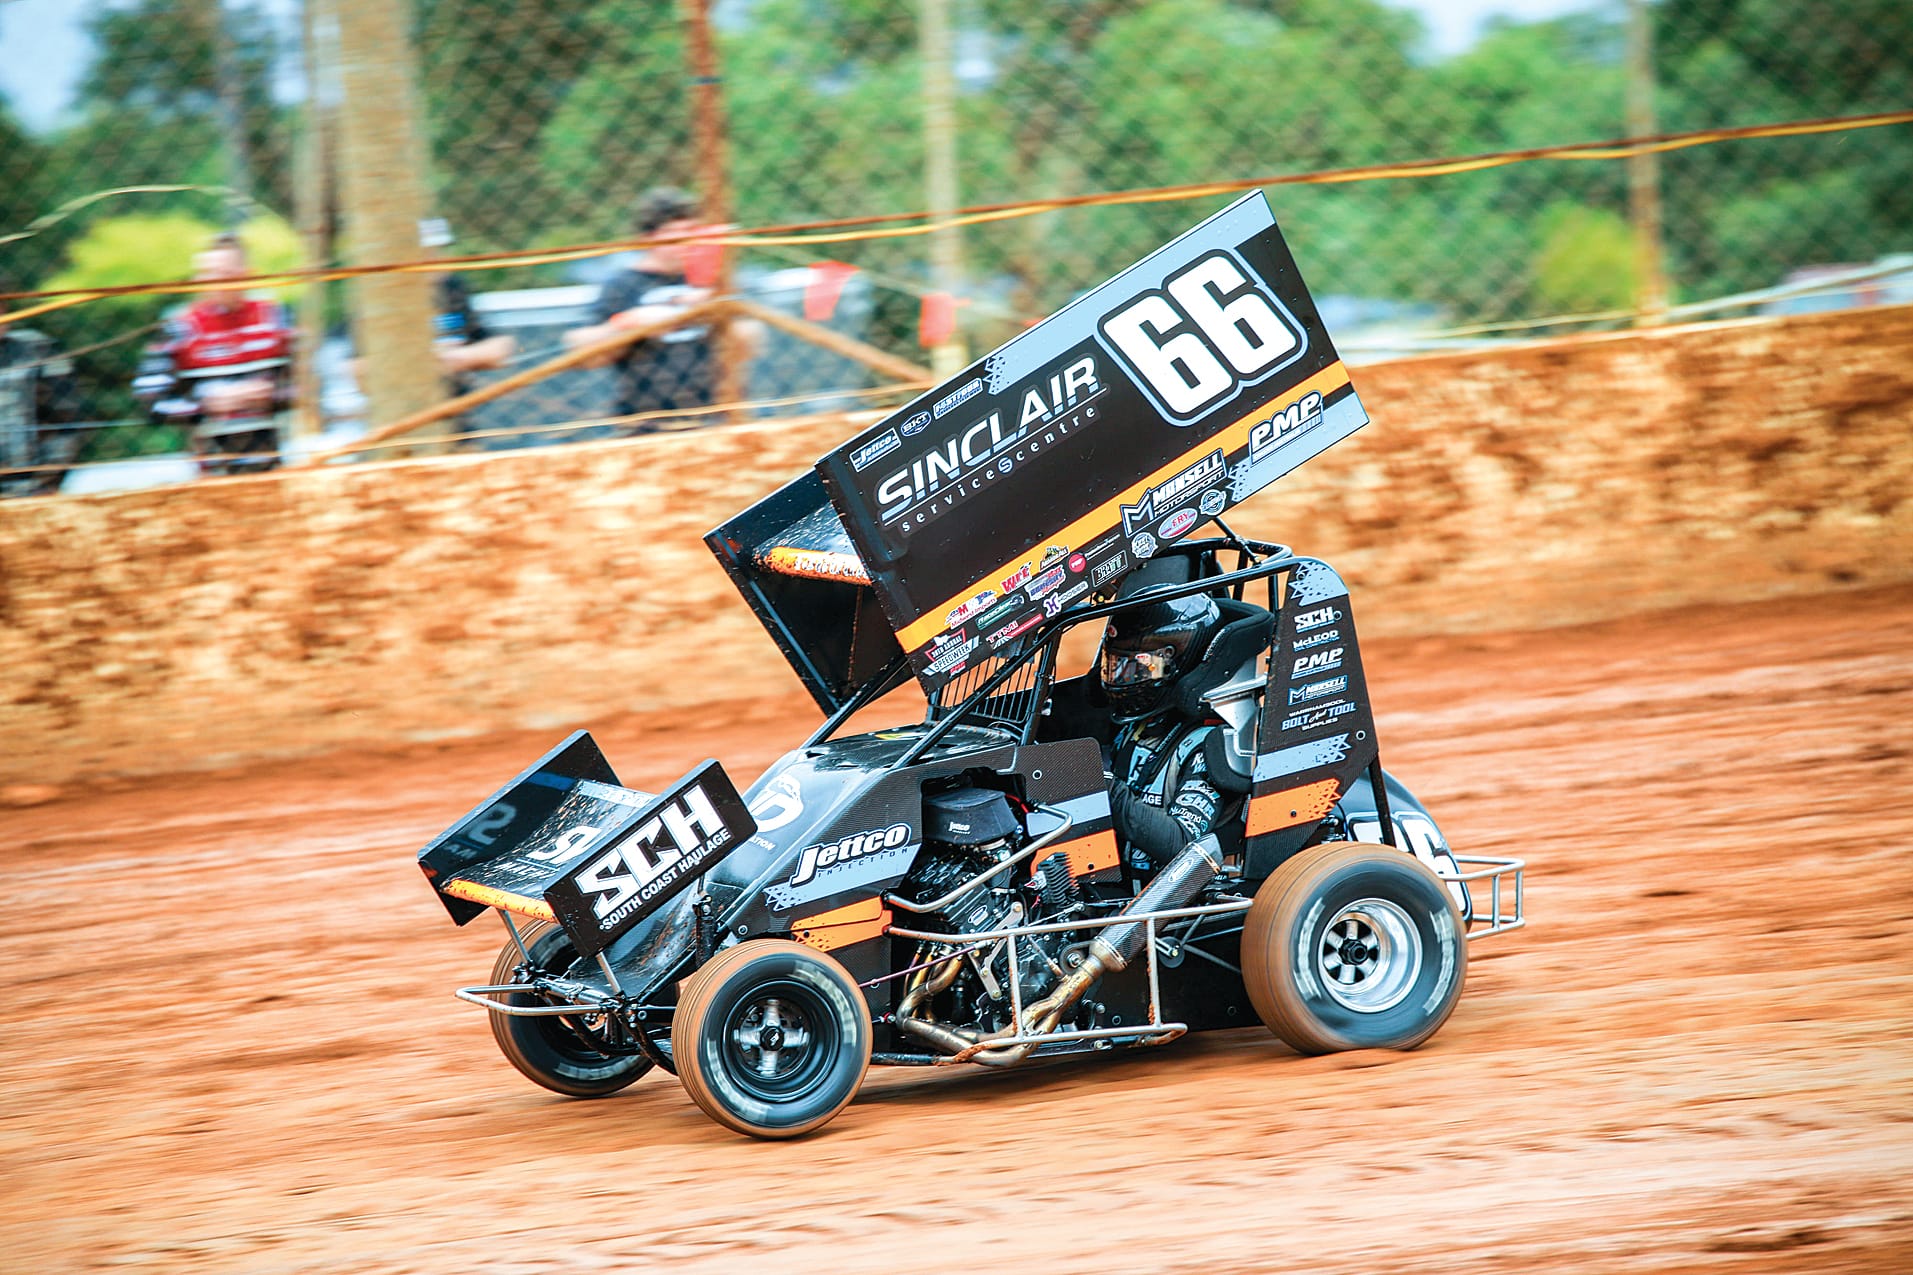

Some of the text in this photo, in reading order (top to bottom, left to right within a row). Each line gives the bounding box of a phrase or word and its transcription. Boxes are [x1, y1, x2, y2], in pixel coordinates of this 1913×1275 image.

[1103, 256, 1297, 414] 66
[878, 357, 1099, 522] SINCLAIR
[1252, 392, 1320, 452] PMP
[902, 470, 995, 532] service
[1016, 407, 1095, 461] centre
[1153, 453, 1221, 506] MANSELL
[1293, 630, 1339, 649] McLEOD
[1294, 606, 1334, 630] SCH
[934, 644, 971, 671] SPEEDWEEK
[1293, 648, 1344, 673] PMP
[1282, 714, 1311, 731] BOLT
[1327, 702, 1357, 717] TOOL
[574, 785, 723, 919] SCH
[602, 828, 732, 930] SOUTH COAST HAULAGE
[791, 824, 907, 884] Jettco
